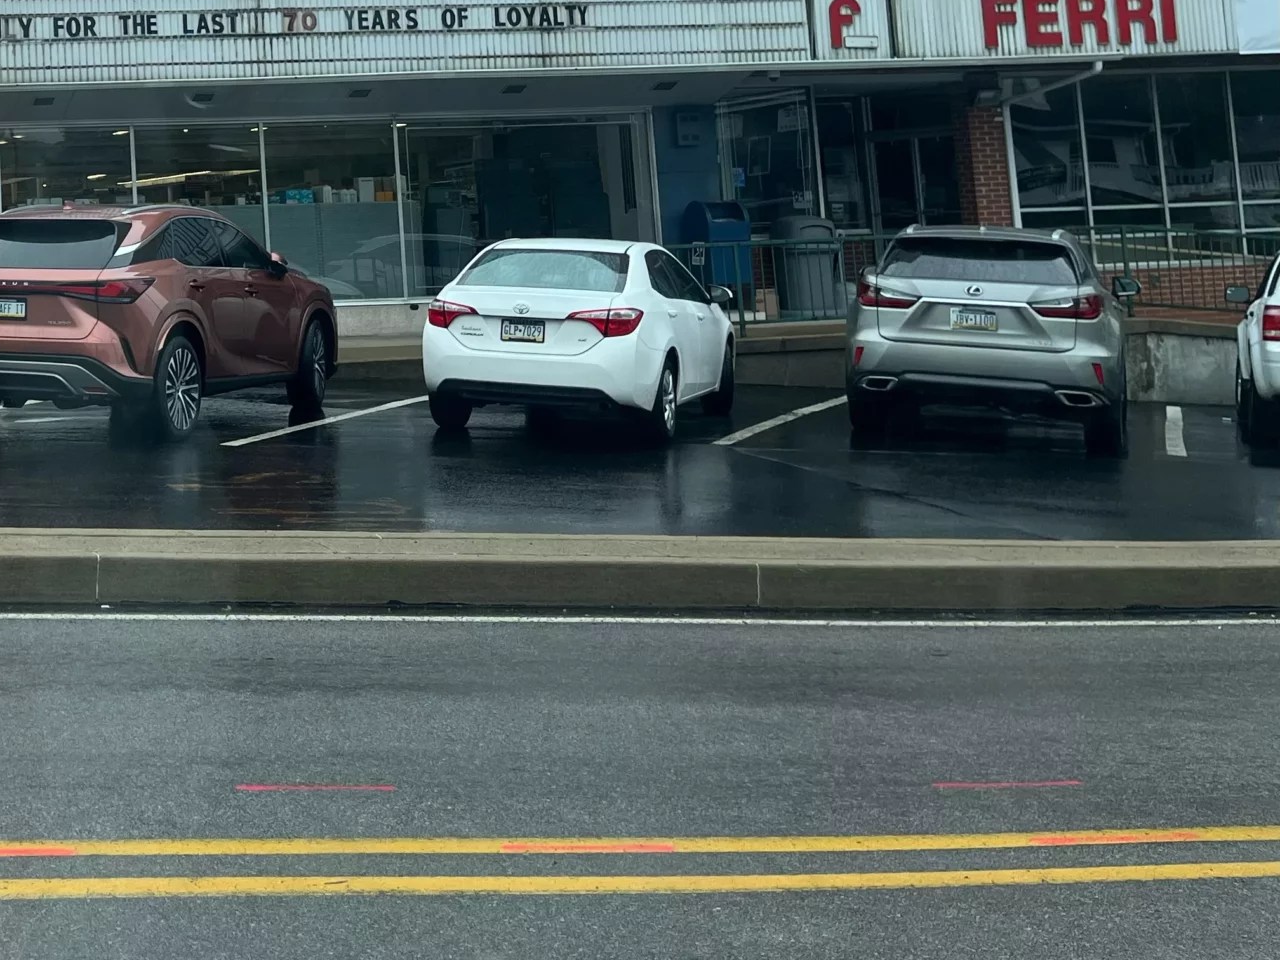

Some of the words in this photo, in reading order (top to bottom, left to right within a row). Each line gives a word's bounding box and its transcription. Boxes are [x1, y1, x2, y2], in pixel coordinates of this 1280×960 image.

[53, 15, 97, 38] FOR
[120, 13, 158, 36] THE
[182, 12, 239, 34] LAST
[283, 10, 317, 32] 70
[344, 8, 419, 31] YEARS
[441, 8, 469, 29] OF
[493, 5, 589, 28] LOYALTY
[15, 304, 24, 315] IT
